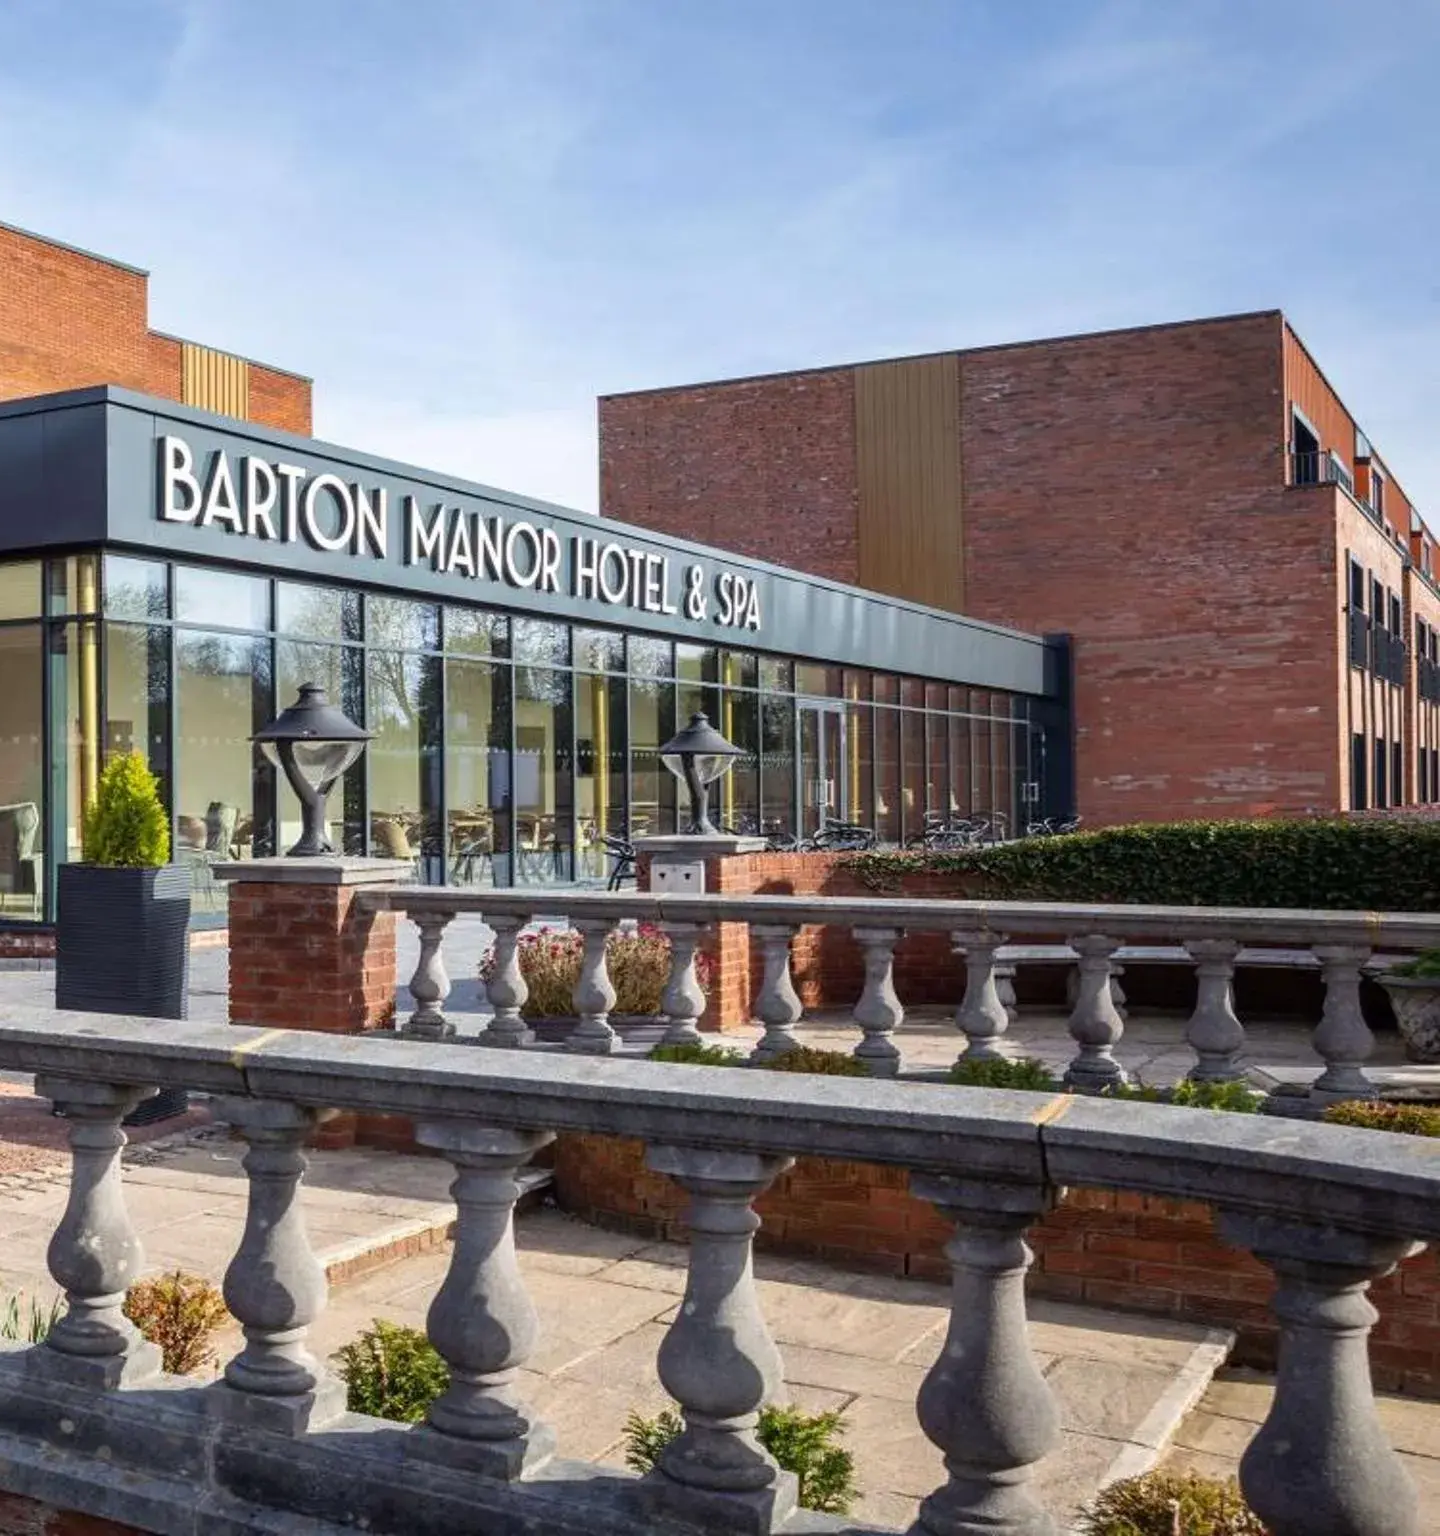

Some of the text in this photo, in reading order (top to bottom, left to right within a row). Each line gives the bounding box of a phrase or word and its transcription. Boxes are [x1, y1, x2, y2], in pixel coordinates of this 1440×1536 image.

[163, 435, 761, 631] BARTON MANOR HOTEL & SPA
